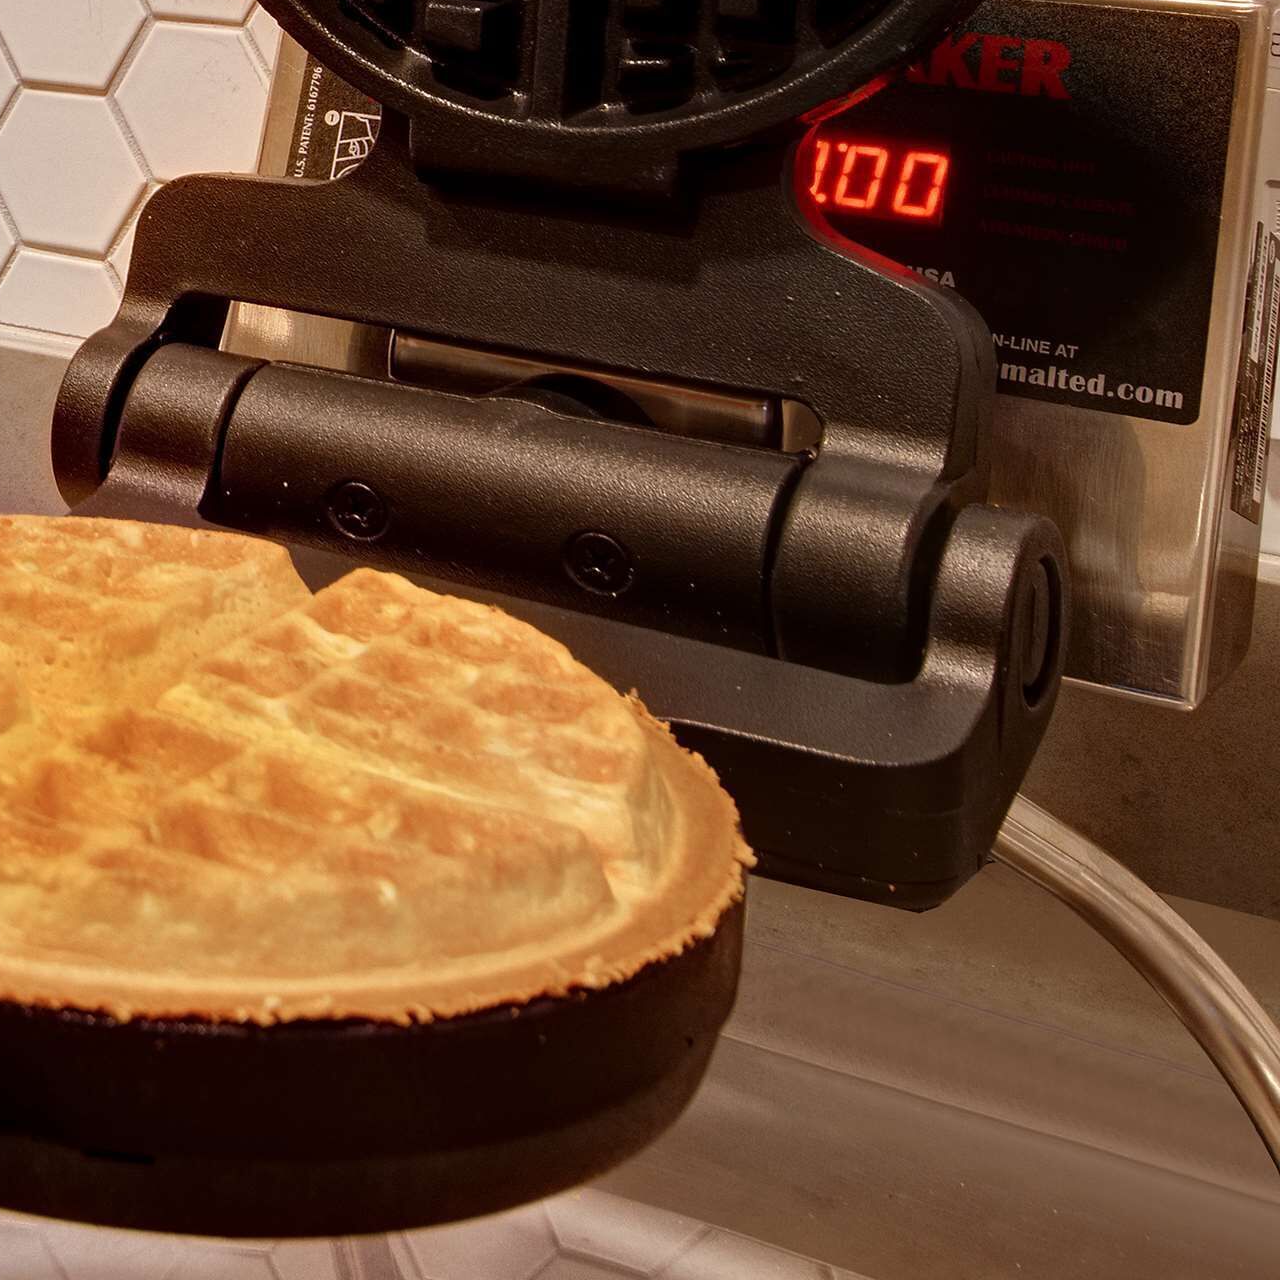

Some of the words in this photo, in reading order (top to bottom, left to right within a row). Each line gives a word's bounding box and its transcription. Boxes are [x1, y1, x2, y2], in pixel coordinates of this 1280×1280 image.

[307, 66, 323, 111] 6167796
[298, 113, 315, 155] PATENT:
[294, 158, 307, 178] U.S.
[1055, 343, 1079, 360] AT
